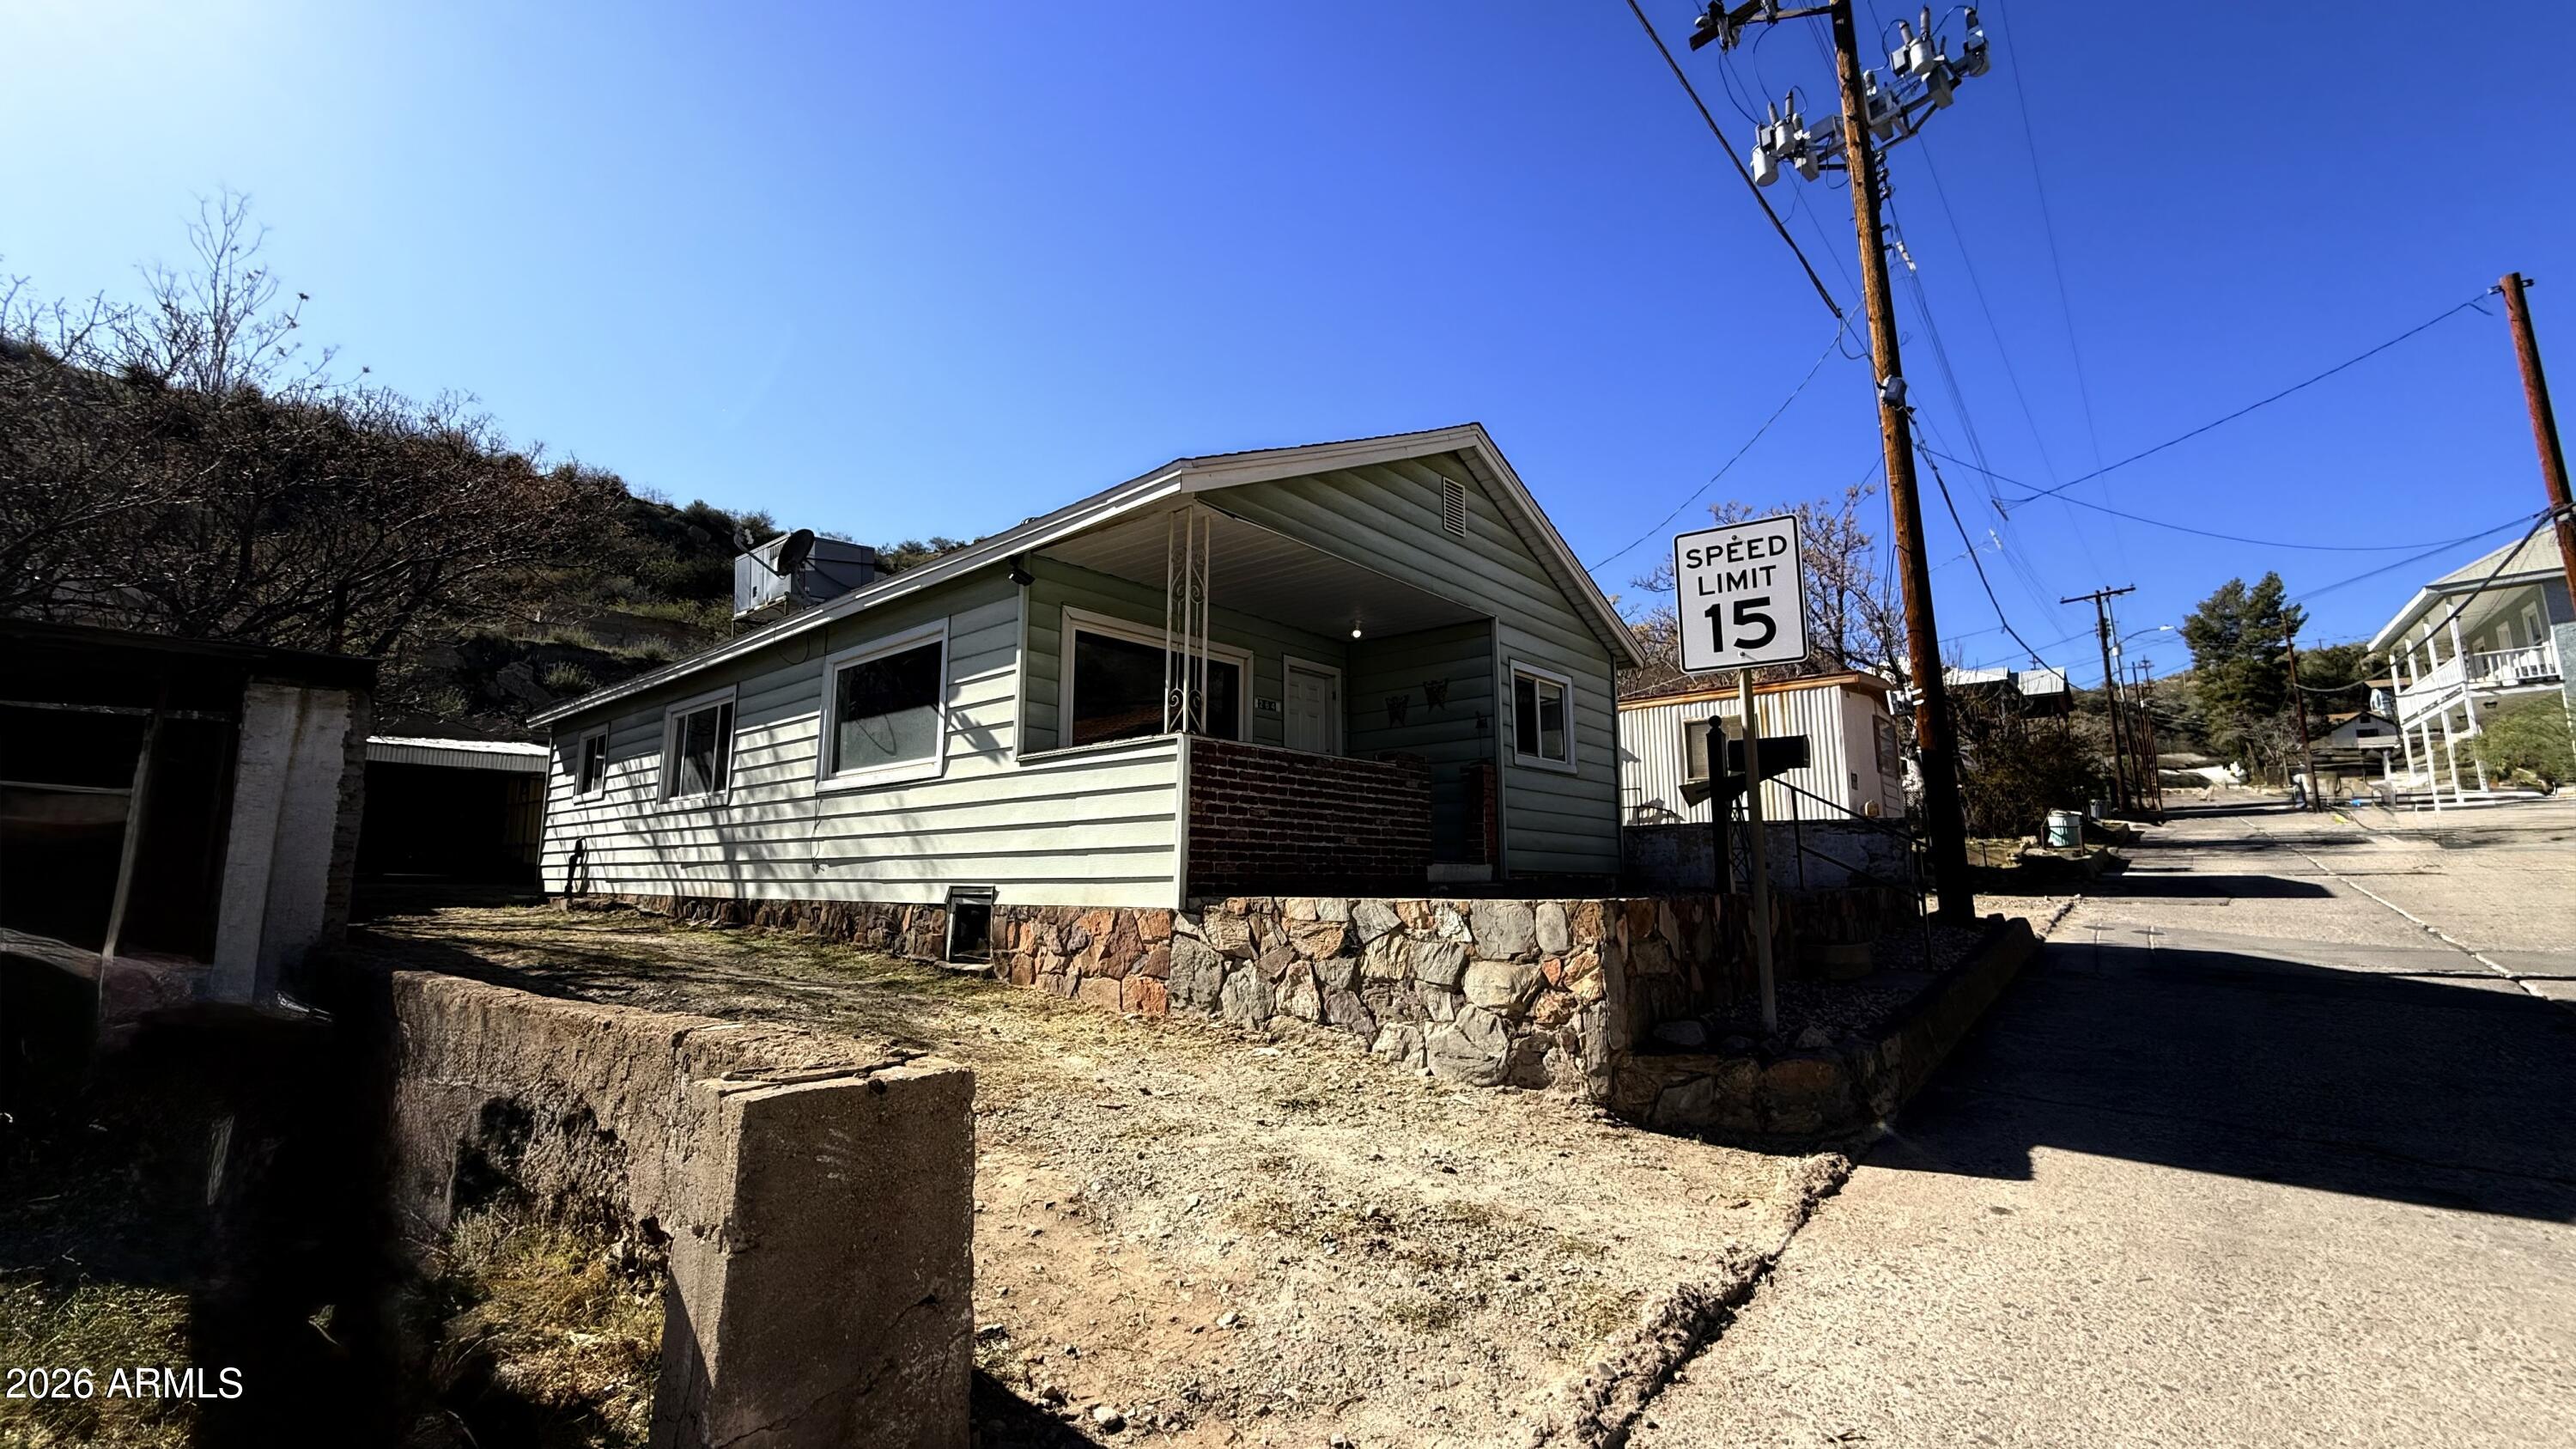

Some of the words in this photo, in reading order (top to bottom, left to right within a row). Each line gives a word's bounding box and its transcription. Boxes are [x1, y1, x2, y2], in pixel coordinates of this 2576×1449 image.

[1686, 535, 1787, 569] SPEED
[1698, 565, 1777, 596] LIMIT
[1704, 596, 1777, 653] 15
